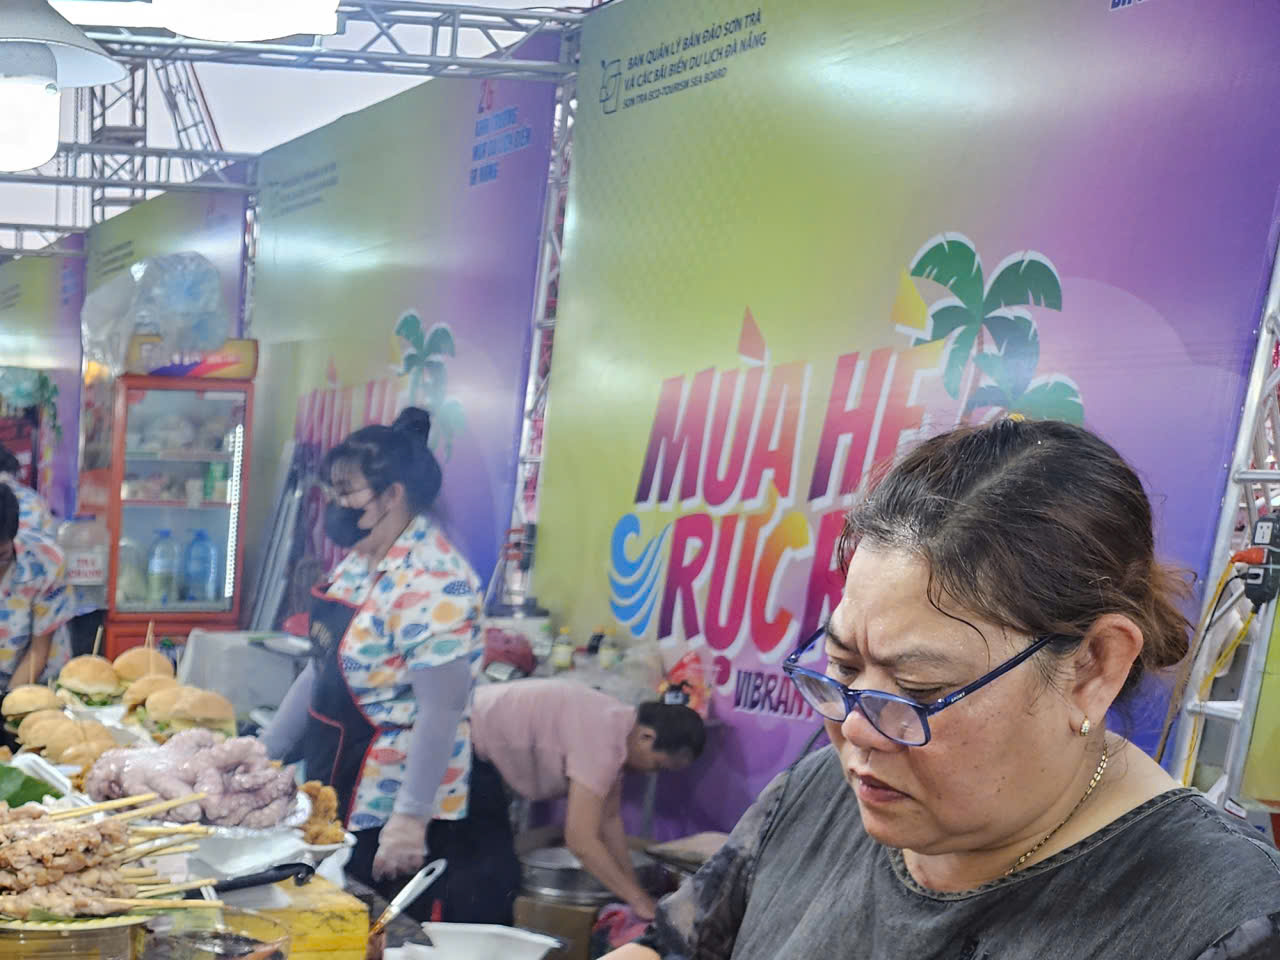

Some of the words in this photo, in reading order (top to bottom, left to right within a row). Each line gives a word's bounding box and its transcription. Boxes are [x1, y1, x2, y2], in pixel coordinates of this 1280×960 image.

[627, 54, 644, 71] BAN
[634, 303, 803, 508] MÙA
[734, 670, 814, 719] VIBRAN
